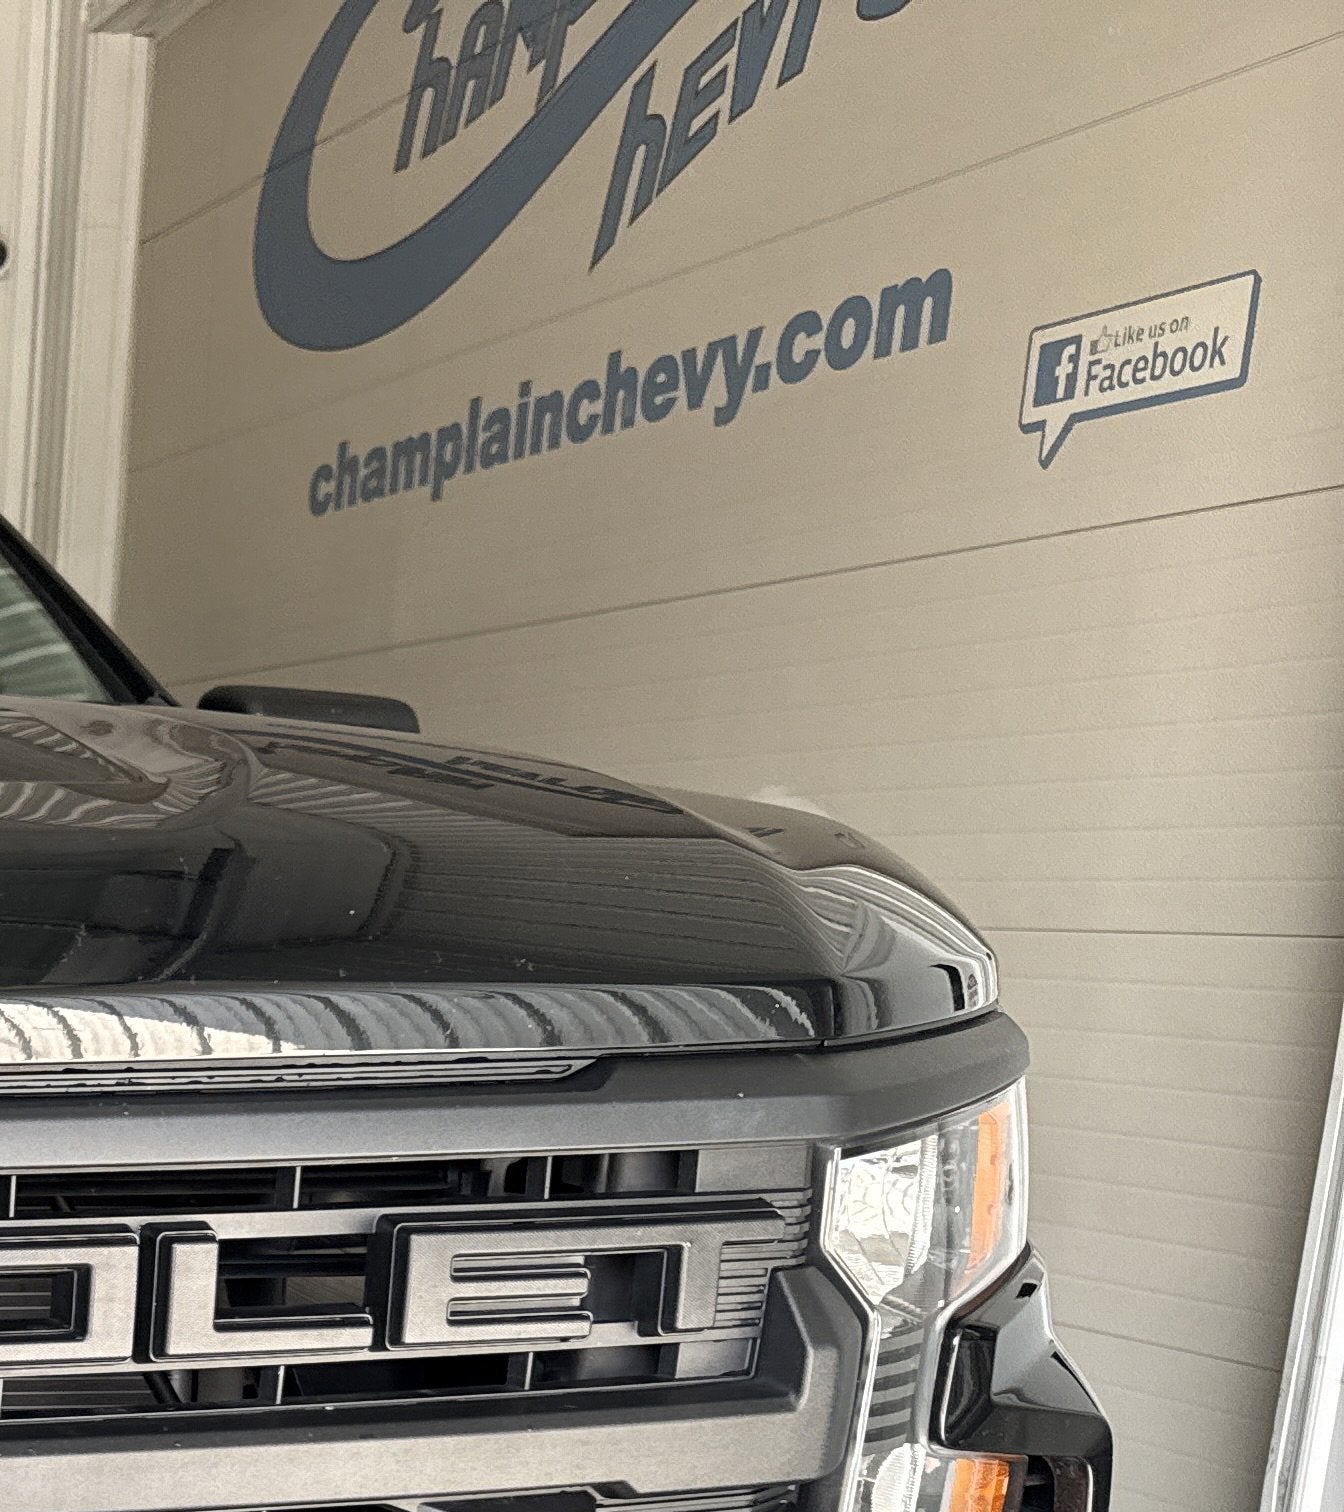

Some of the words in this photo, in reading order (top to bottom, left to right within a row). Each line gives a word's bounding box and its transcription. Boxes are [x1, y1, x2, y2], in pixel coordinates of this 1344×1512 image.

[1083, 326, 1229, 397] Facebook
[1114, 325, 1144, 348] Like
[1148, 321, 1167, 340] us
[1169, 315, 1190, 334] on
[308, 267, 953, 517] champlainchevy.com
